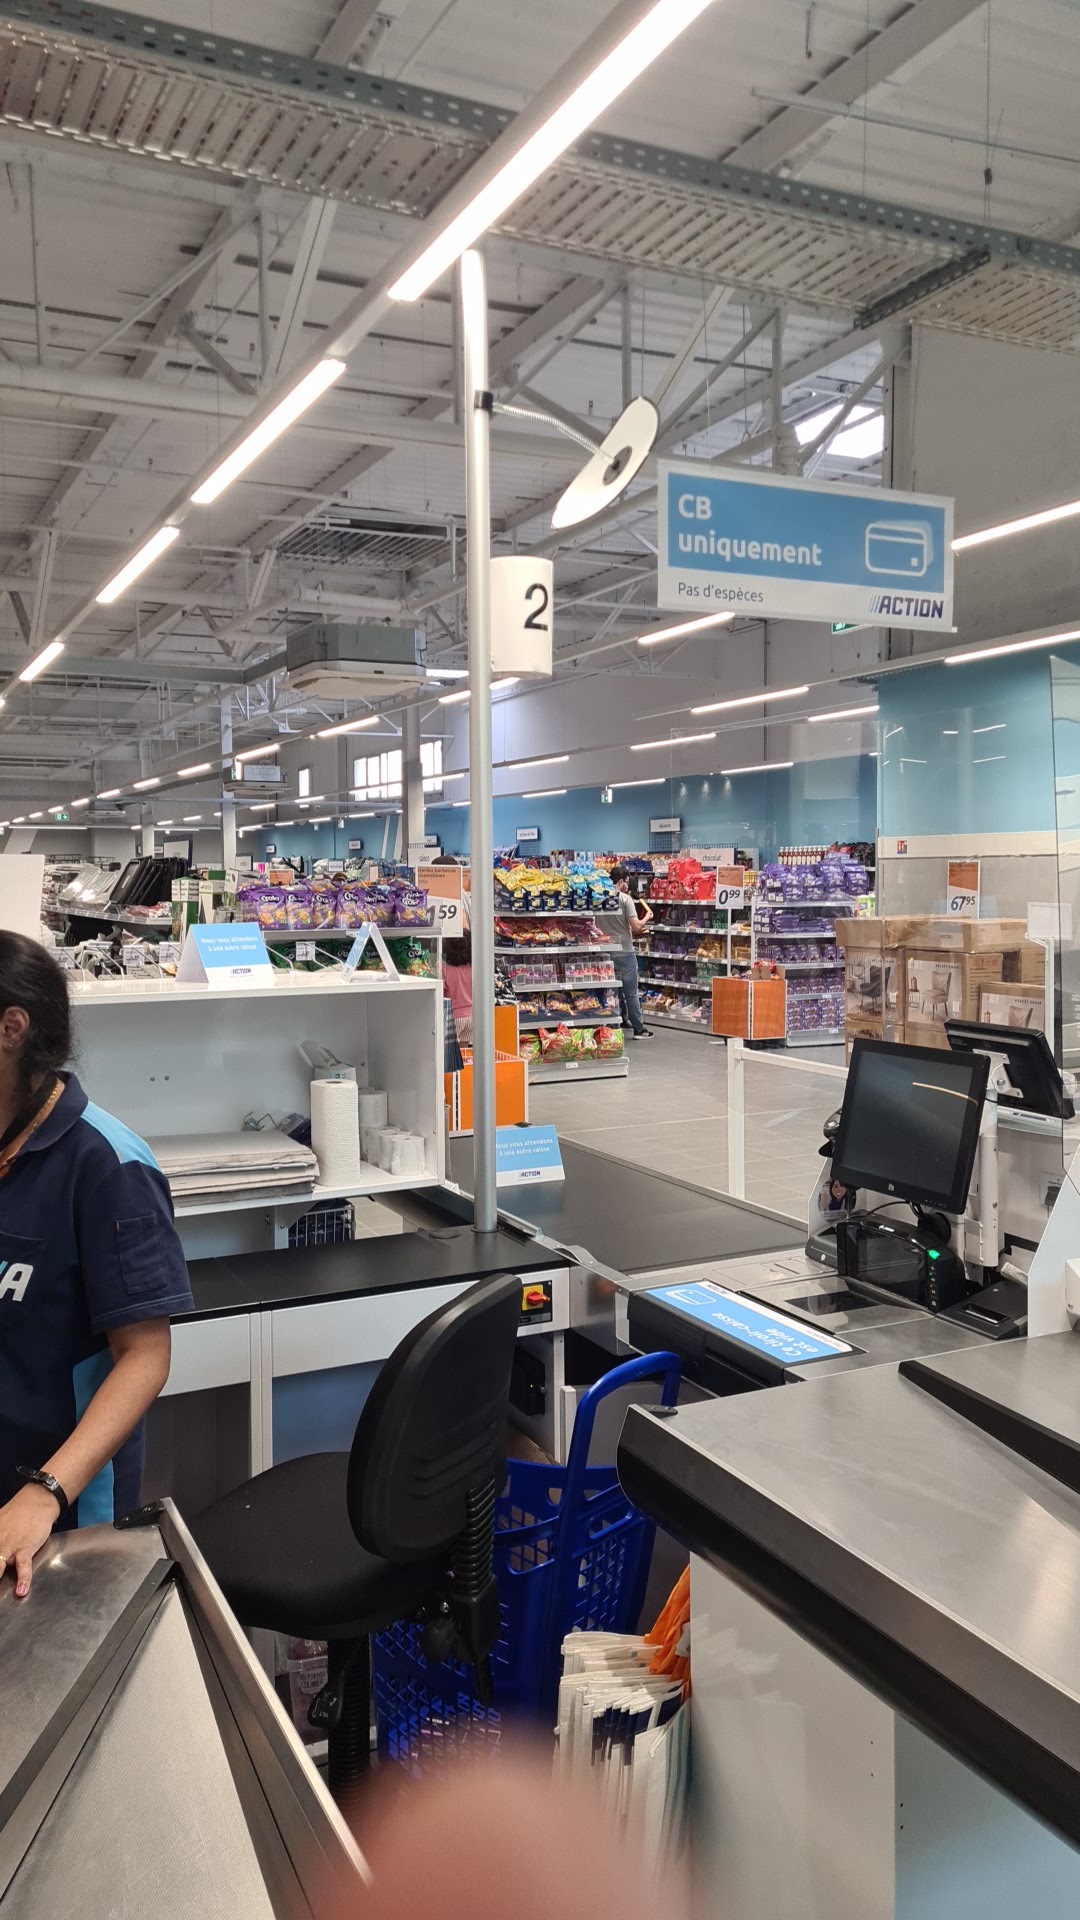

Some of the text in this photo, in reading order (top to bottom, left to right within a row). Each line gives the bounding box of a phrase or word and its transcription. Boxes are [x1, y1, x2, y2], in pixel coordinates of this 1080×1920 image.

[678, 494, 712, 520] CB
[678, 529, 822, 566] uniquement
[678, 582, 764, 603] Pas d'espèces
[524, 583, 549, 632] 2
[877, 595, 944, 619] ACTION
[766, 1328, 796, 1343] vide
[782, 1346, 802, 1356] Ce
[793, 1341, 819, 1353] est
